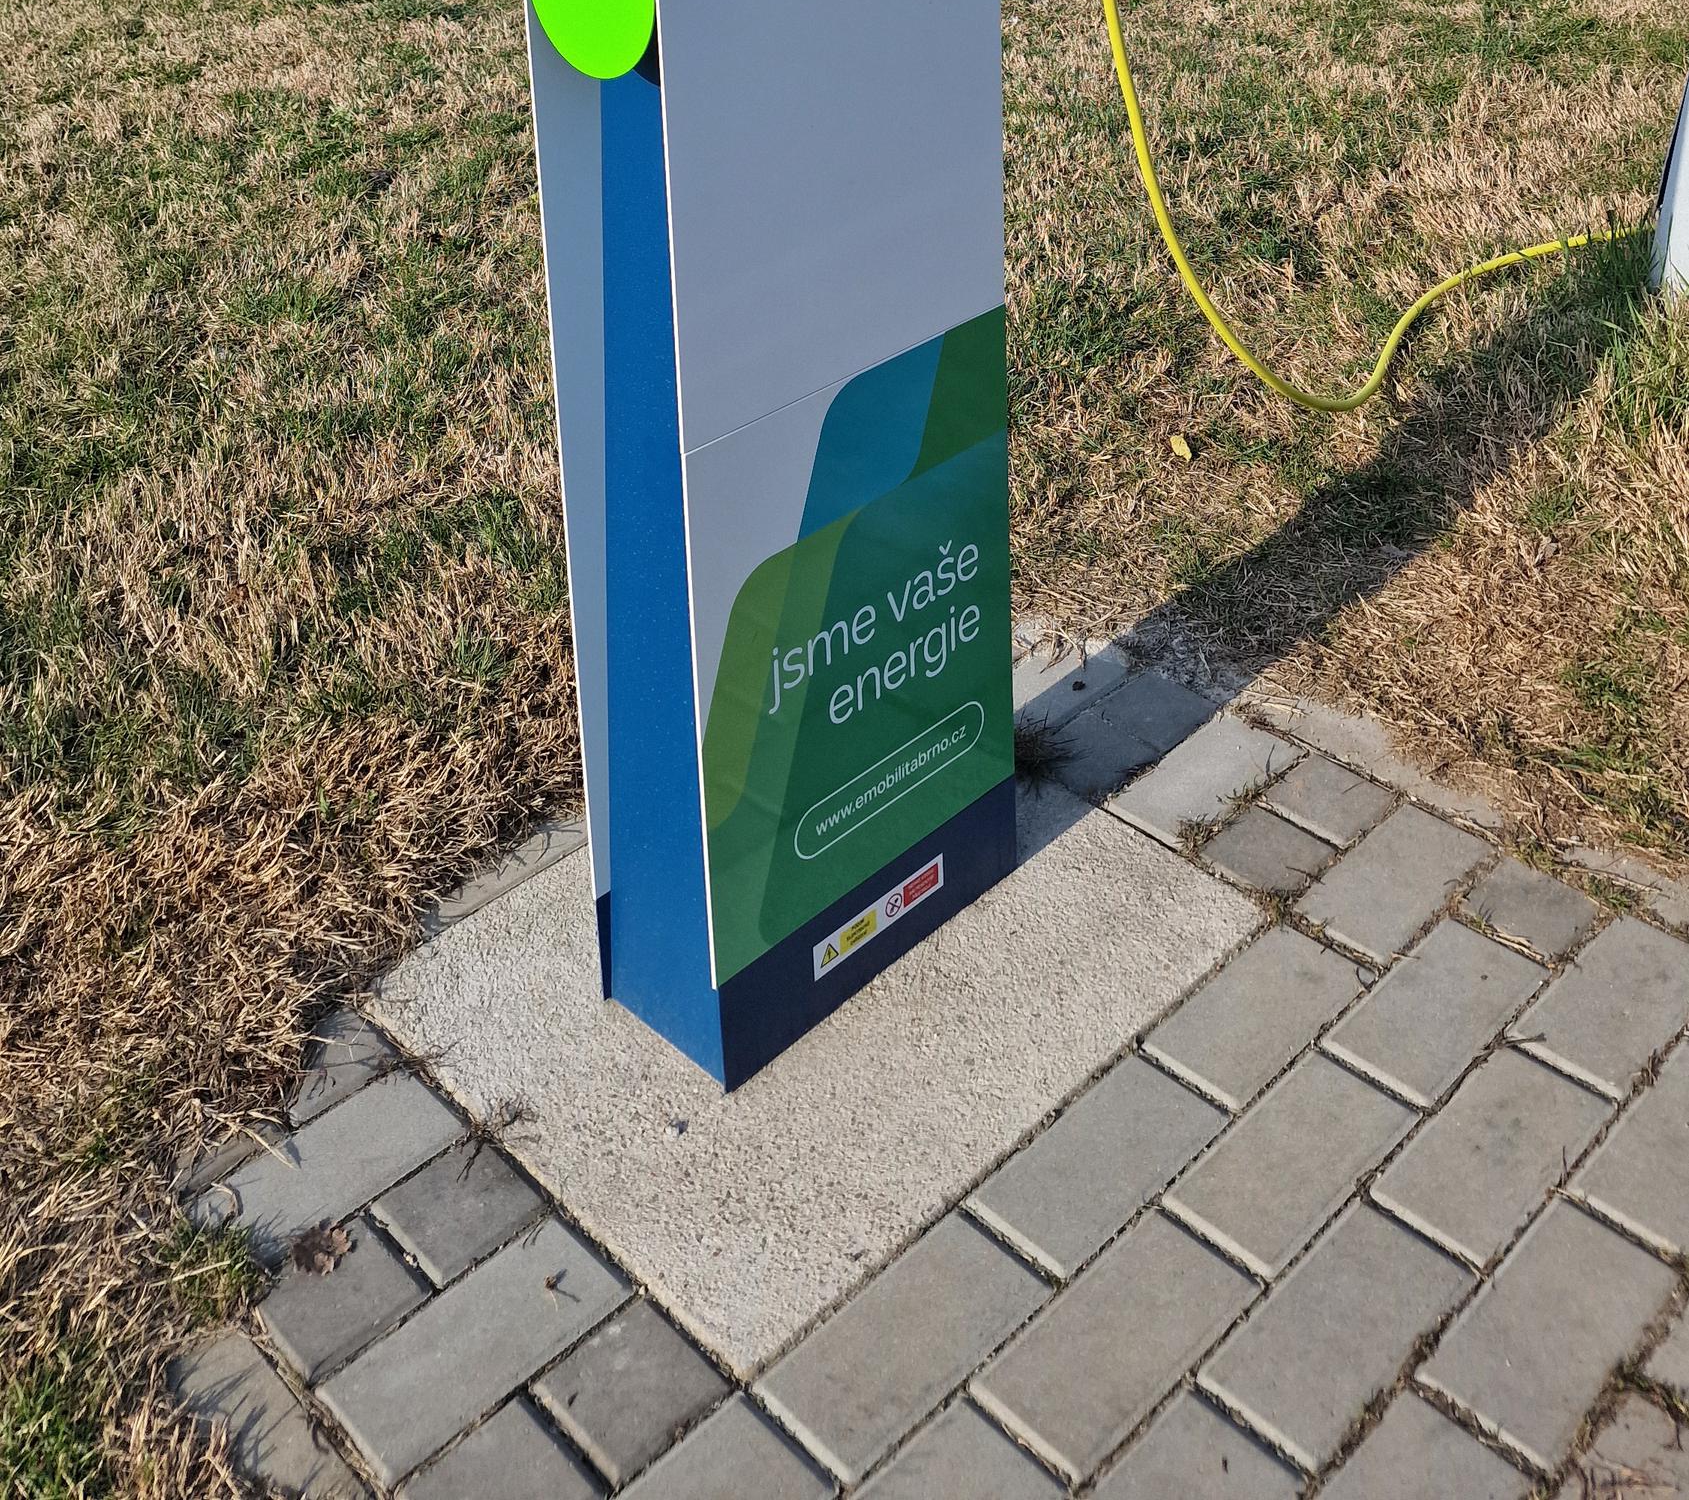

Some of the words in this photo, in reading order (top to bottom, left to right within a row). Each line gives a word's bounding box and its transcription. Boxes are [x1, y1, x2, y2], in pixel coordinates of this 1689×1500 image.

[769, 605, 876, 715] jsme
[887, 540, 979, 622] vaše
[829, 605, 980, 724] energie
[815, 725, 967, 836] www.emobilitabrno.cz
